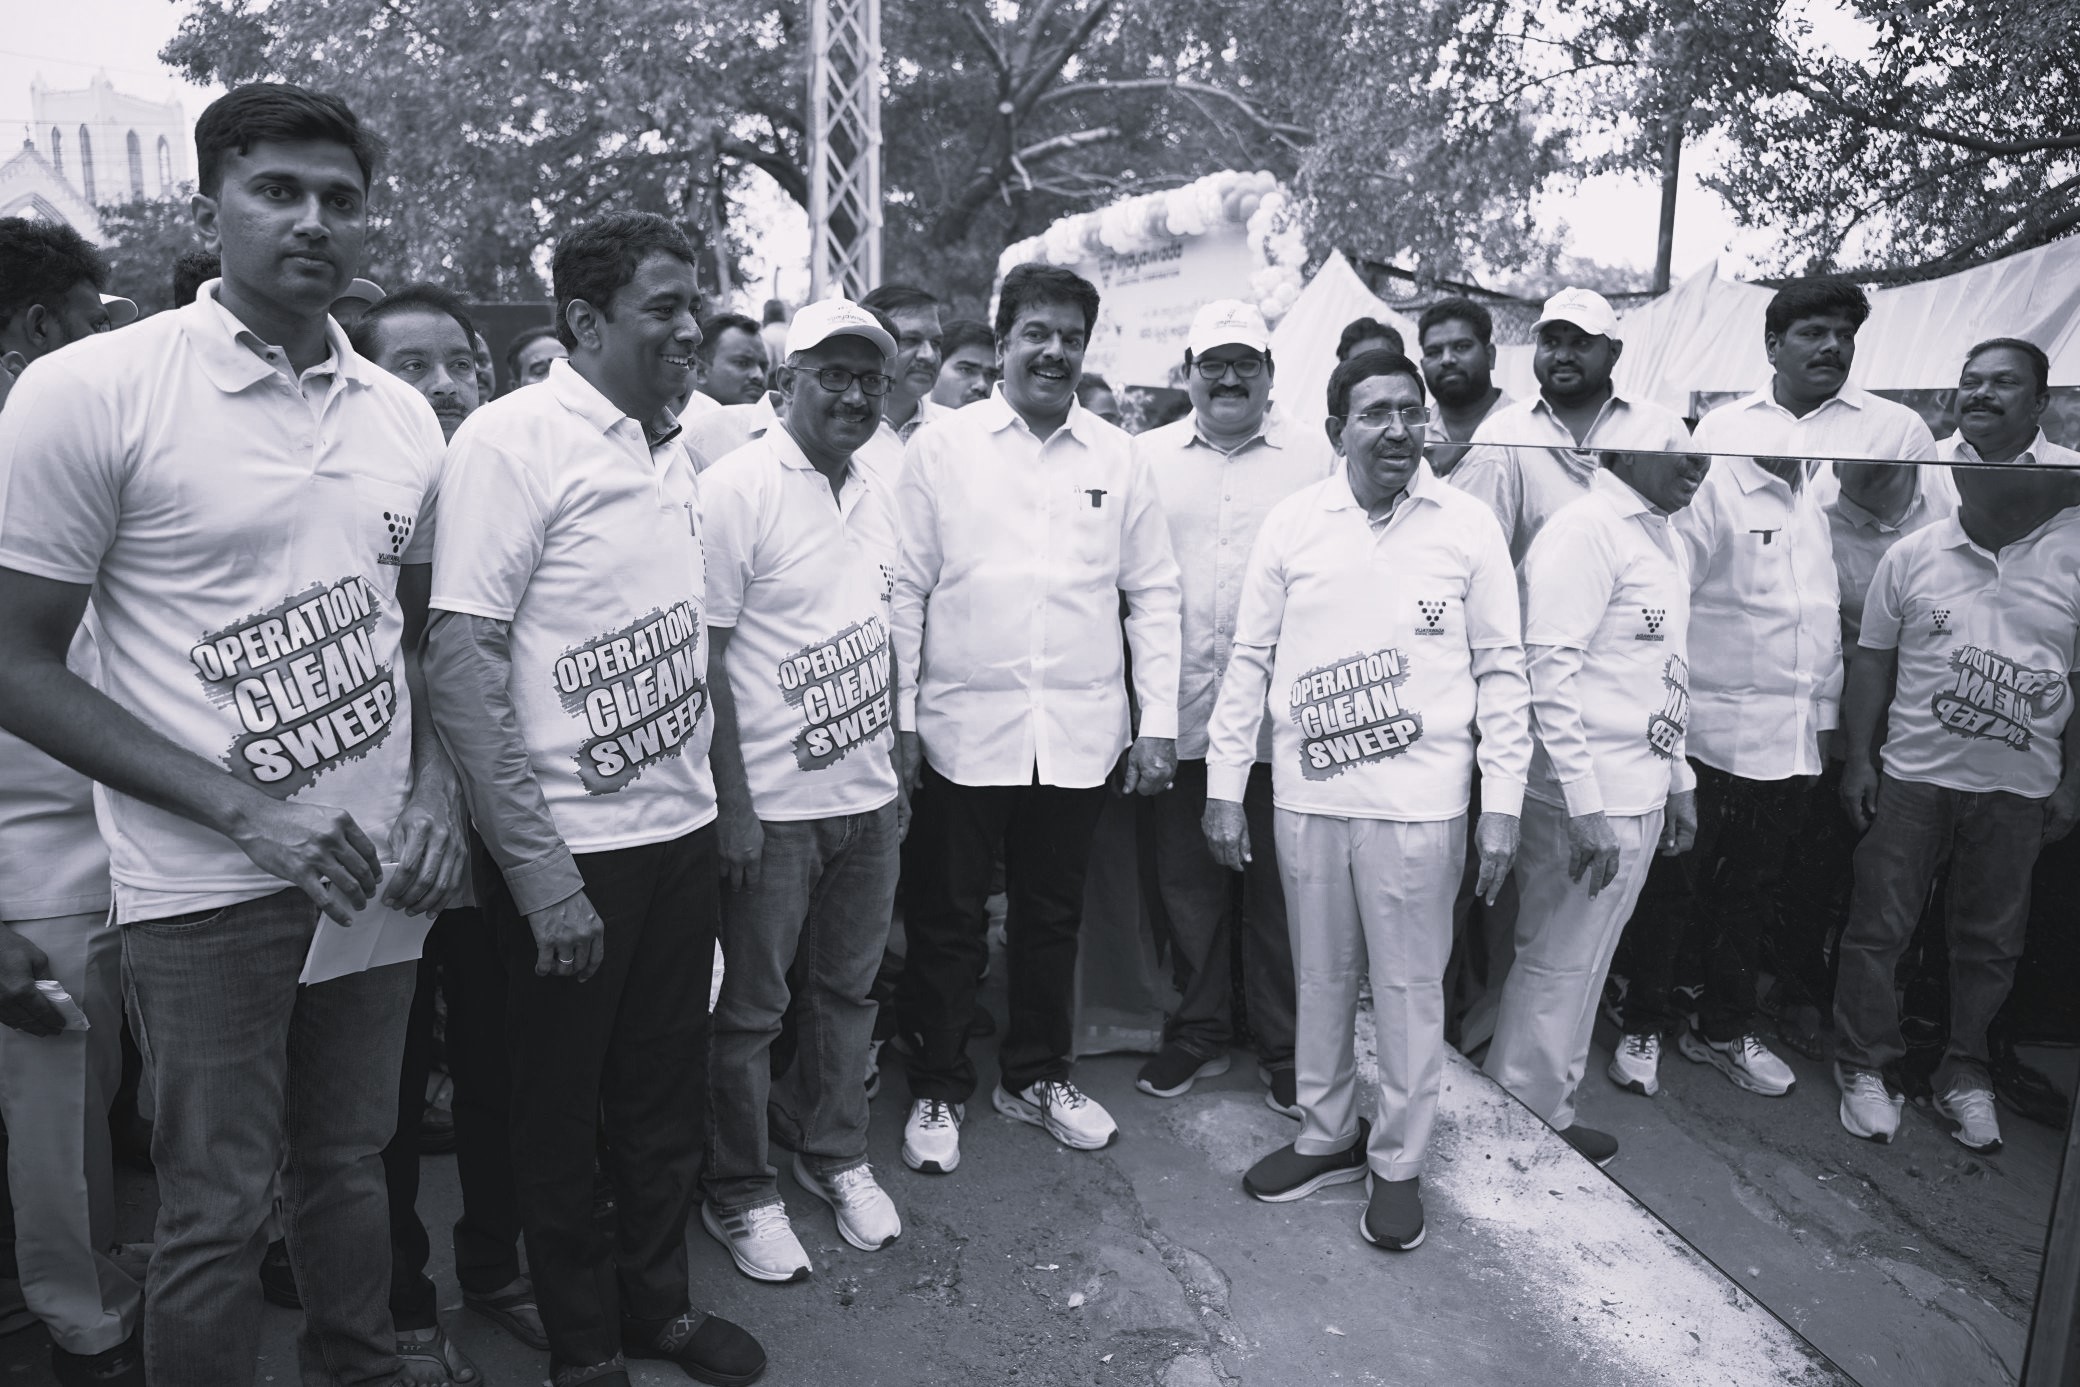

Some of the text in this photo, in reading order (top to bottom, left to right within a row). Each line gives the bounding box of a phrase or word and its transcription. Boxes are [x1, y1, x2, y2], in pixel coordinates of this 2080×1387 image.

[190, 576, 371, 682] OPERATION
[555, 602, 695, 694] OPERATION
[779, 616, 885, 691] OPERATION
[234, 625, 378, 734] CLEAN
[585, 643, 695, 738] CLEAN
[801, 650, 889, 726] CLEAN
[1291, 648, 1401, 707] OPERATION
[1301, 681, 1400, 740] CLEAN
[243, 680, 394, 783] SWEEP
[590, 690, 704, 778] SWEEP
[1307, 718, 1418, 770] SWEEP
